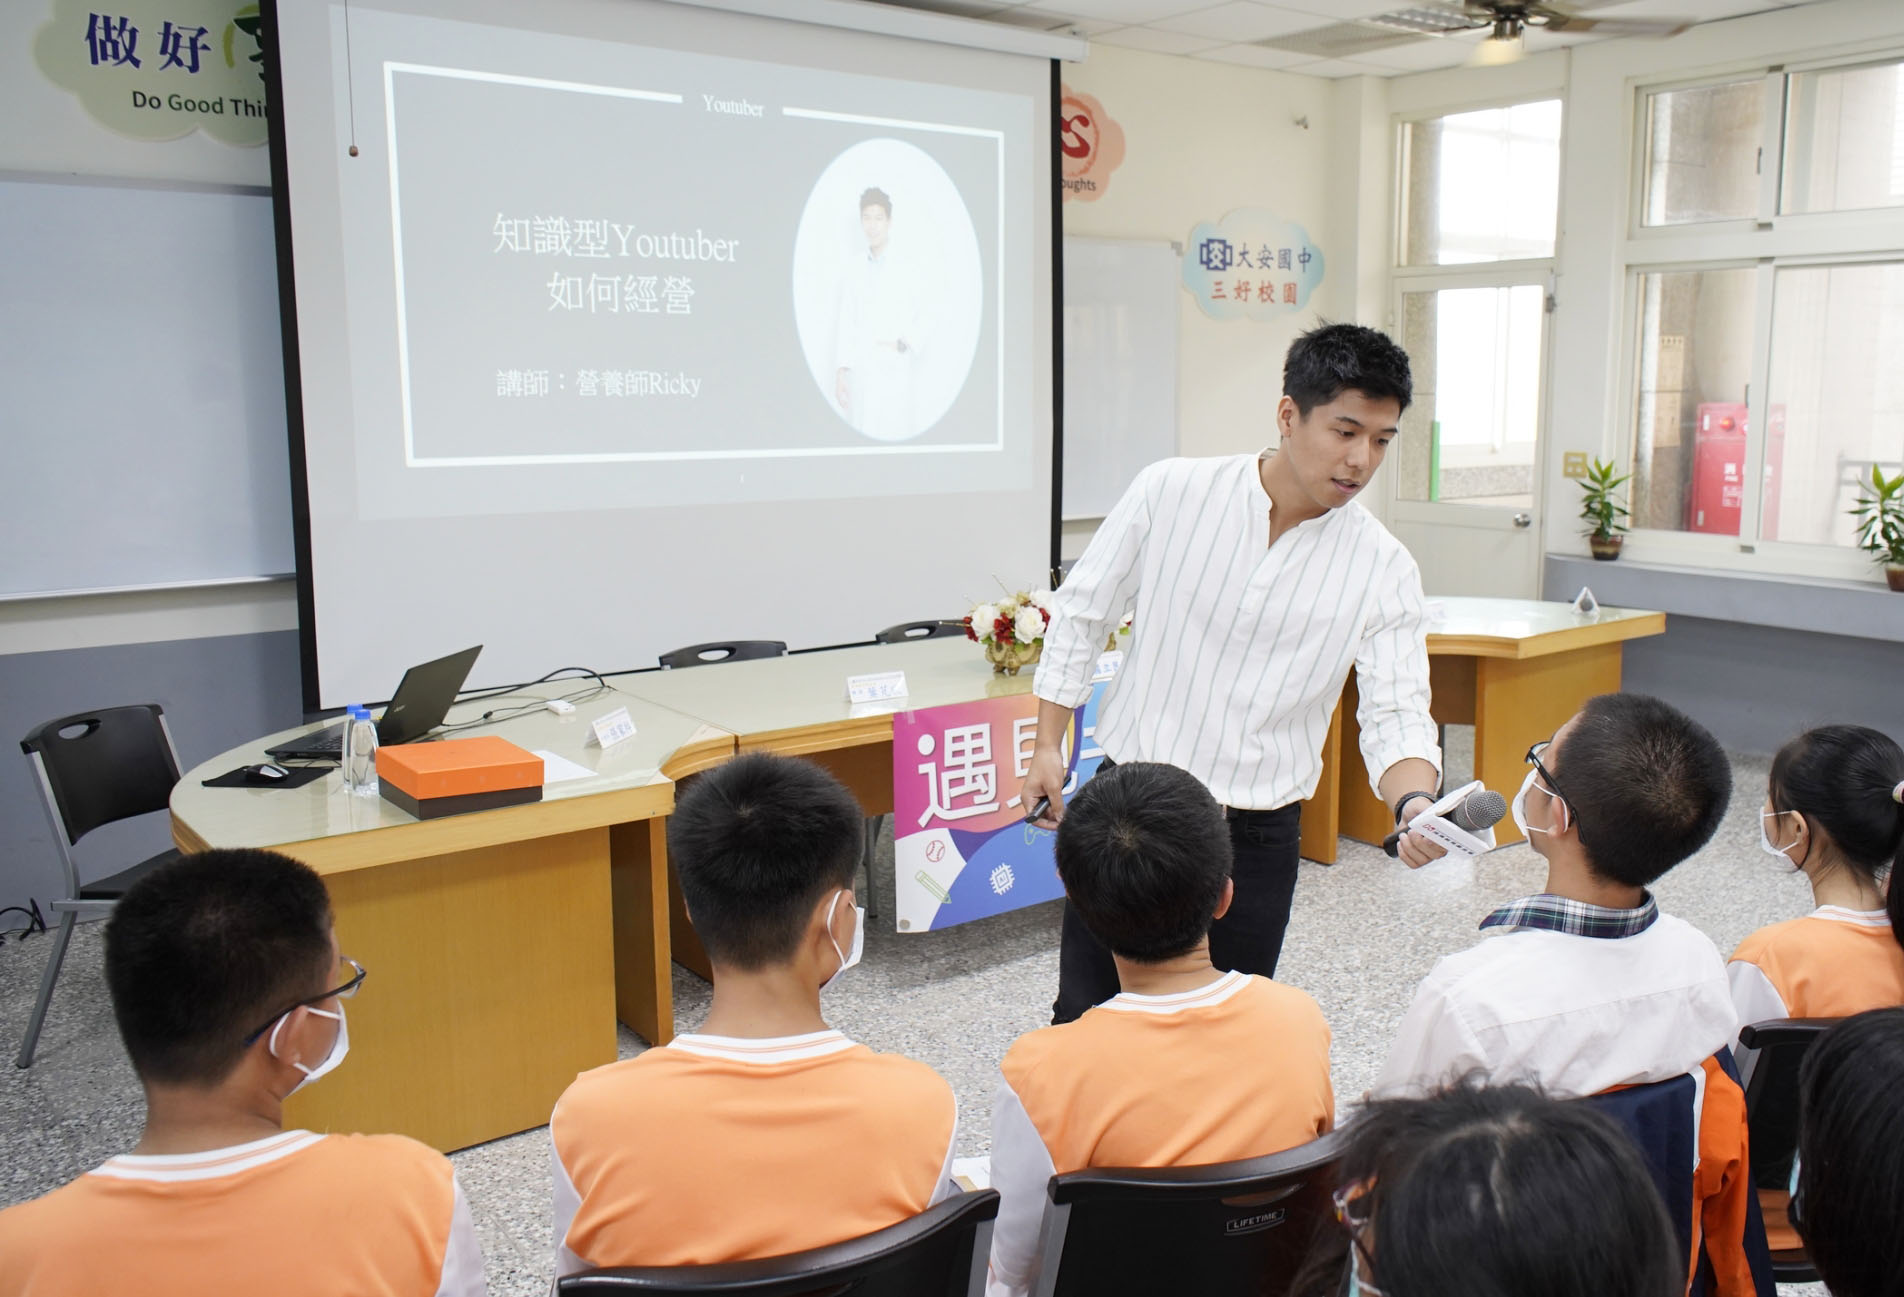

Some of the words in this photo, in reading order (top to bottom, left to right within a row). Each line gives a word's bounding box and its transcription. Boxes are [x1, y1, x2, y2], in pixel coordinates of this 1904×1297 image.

[132, 91, 162, 109] Do
[168, 94, 224, 115] Good
[702, 94, 765, 117] Youtuber
[1061, 178, 1096, 193] oughts
[493, 212, 740, 262] 知識型Youtuber
[1237, 242, 1312, 273] 大安國中
[546, 271, 696, 315] 如何經營
[1211, 280, 1297, 305] 三好校園
[1233, 1211, 1278, 1229] LIFETIME
